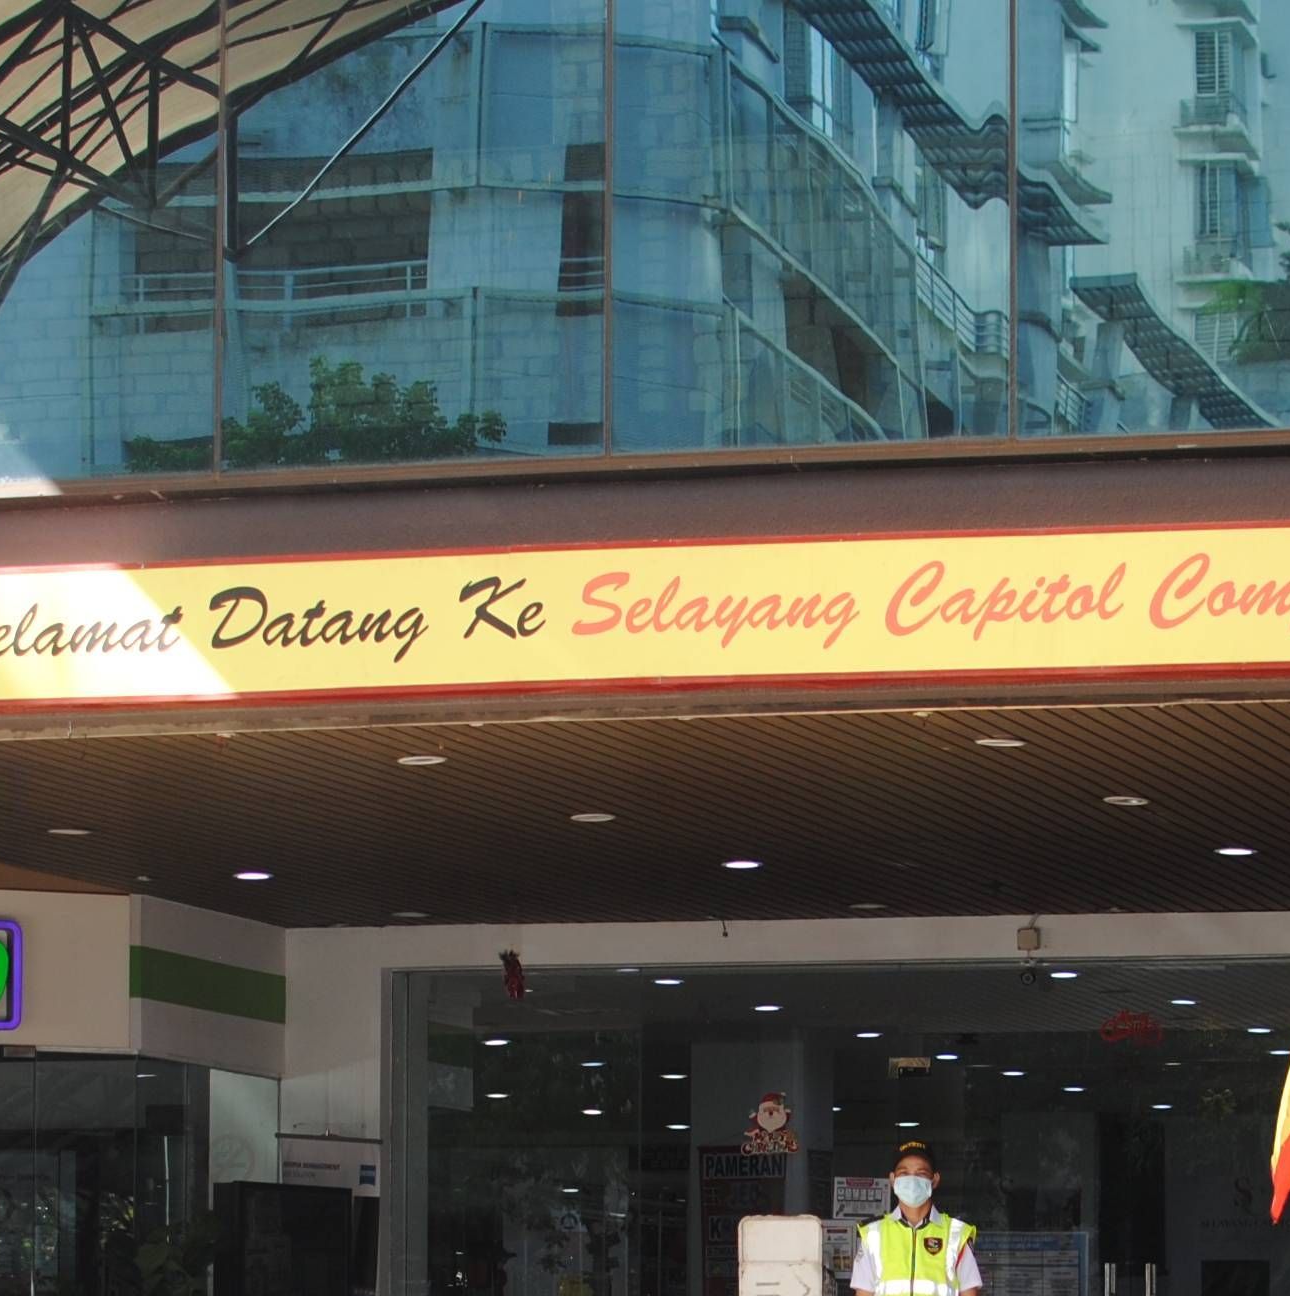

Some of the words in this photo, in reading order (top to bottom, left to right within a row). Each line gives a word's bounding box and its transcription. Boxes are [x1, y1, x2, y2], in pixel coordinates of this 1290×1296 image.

[209, 586, 429, 663] Datang
[459, 576, 546, 639] Ke
[571, 571, 860, 649] Selayang
[884, 560, 1125, 640] Capitol
[706, 1154, 783, 1177] PAMERAN
